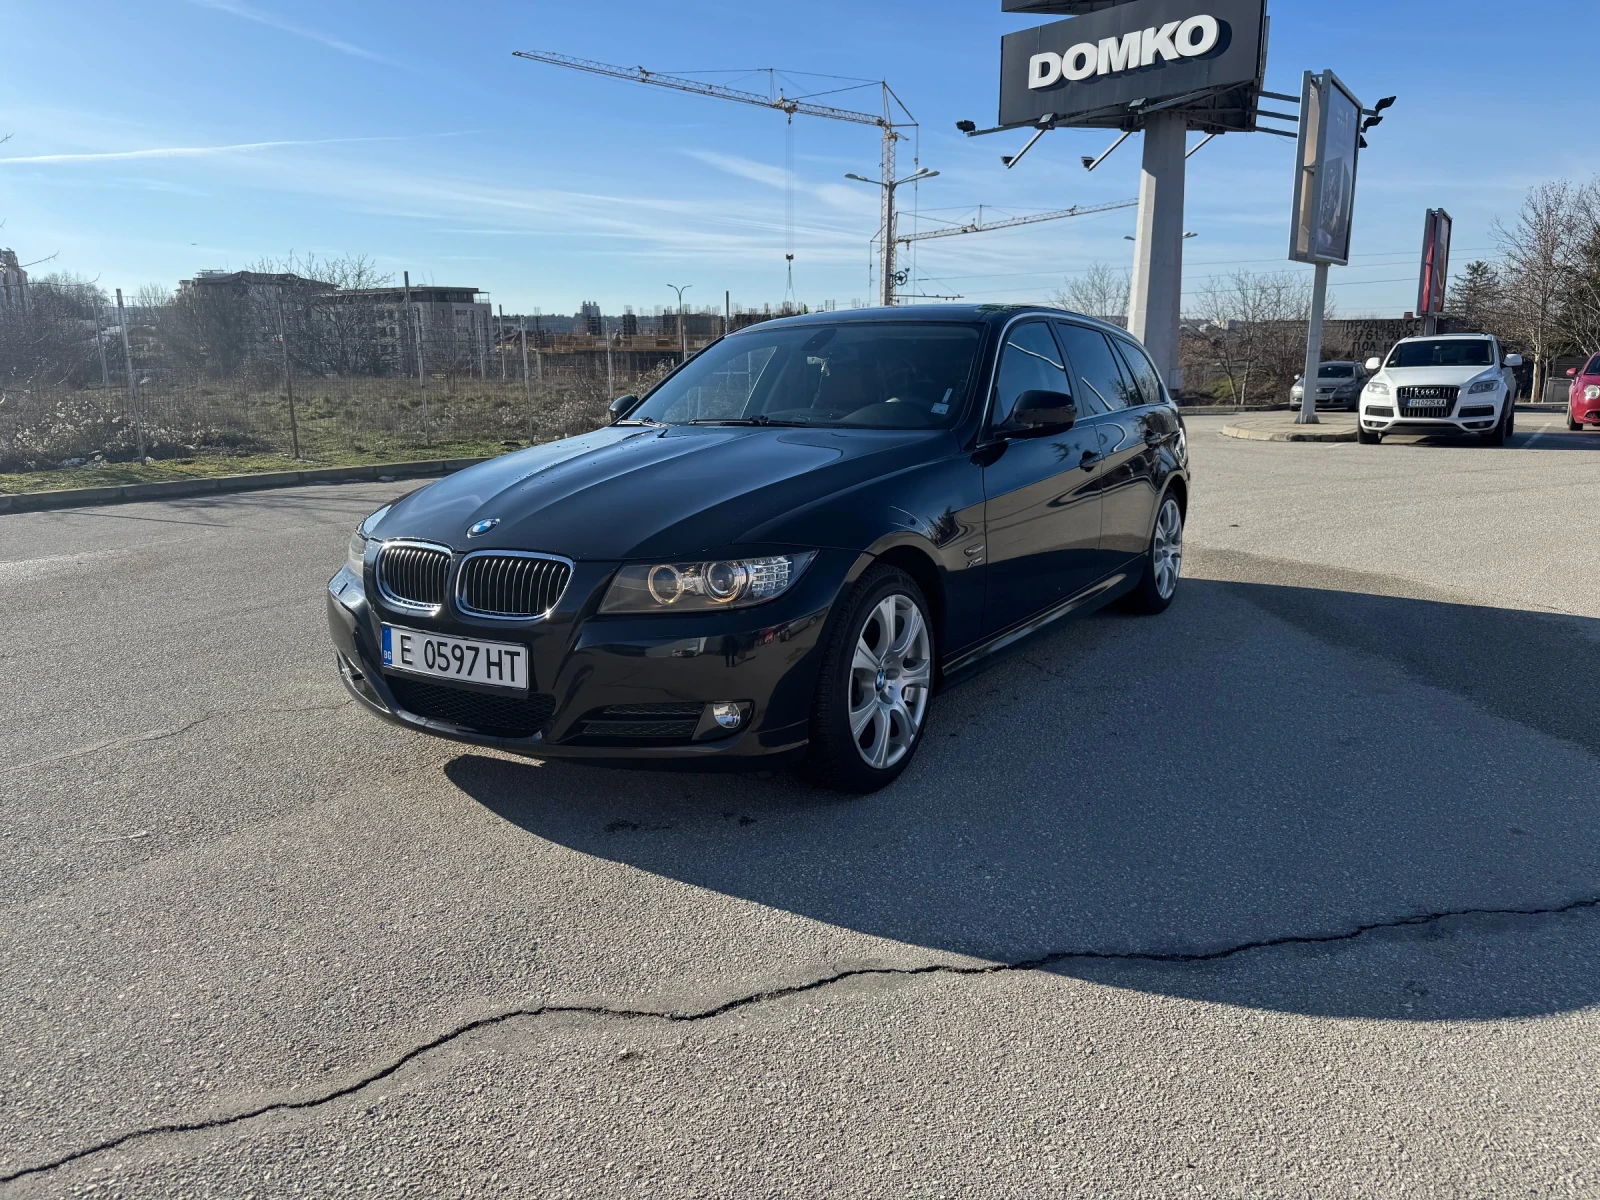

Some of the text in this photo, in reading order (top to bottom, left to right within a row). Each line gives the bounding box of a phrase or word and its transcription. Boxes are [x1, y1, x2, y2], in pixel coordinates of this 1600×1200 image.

[1028, 14, 1220, 89] DOMKO
[383, 649, 392, 660] BG
[400, 634, 521, 682] E 0597 HT
